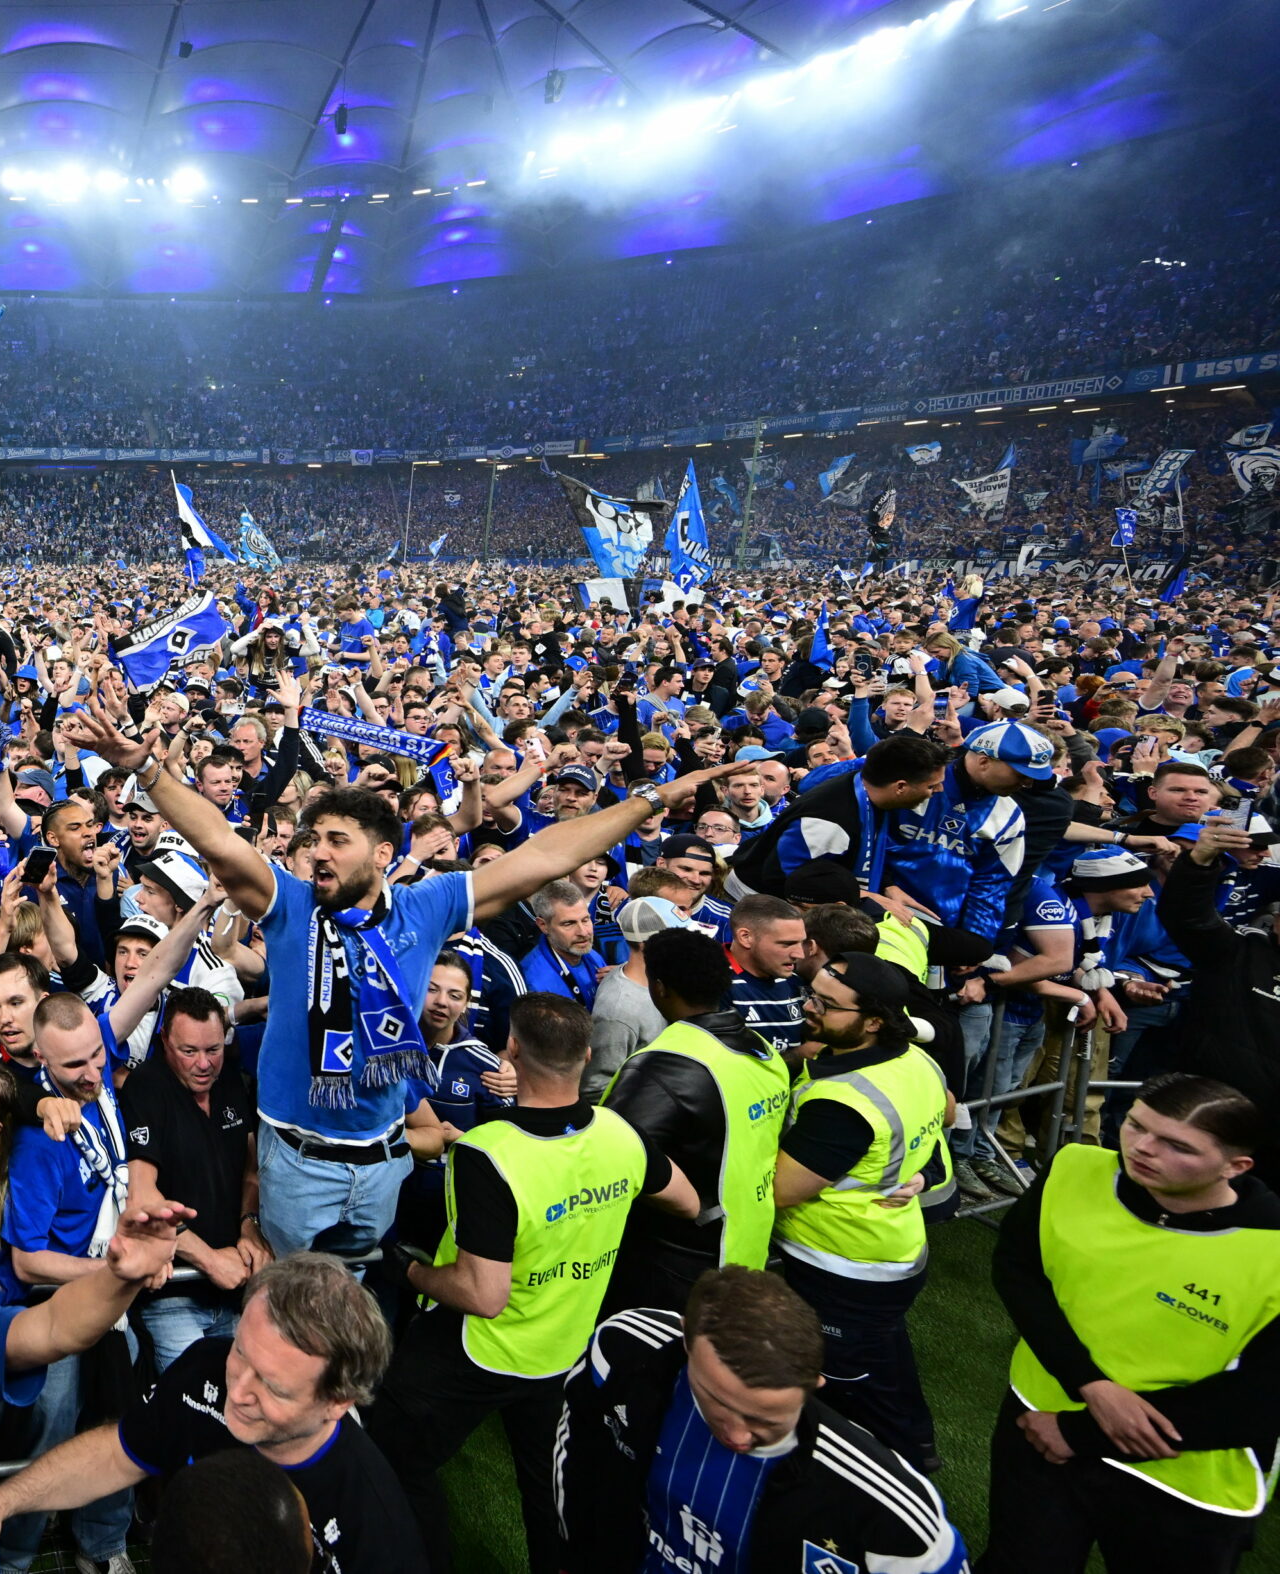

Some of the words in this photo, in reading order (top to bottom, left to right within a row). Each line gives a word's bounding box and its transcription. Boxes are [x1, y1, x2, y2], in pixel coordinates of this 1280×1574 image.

[929, 397, 953, 411] HSV
[957, 395, 981, 408] FAN
[984, 390, 1021, 405] CLUB
[1025, 380, 1104, 400] ROTHOSEN
[303, 714, 401, 747] HAMBURGER
[159, 836, 185, 847] HSV
[128, 916, 160, 929] HSV
[322, 978, 331, 1002] NUR
[569, 1178, 628, 1211] POWER
[528, 1261, 567, 1286] EVENT
[1183, 1282, 1221, 1306] 441
[1177, 1302, 1230, 1334] POWER
